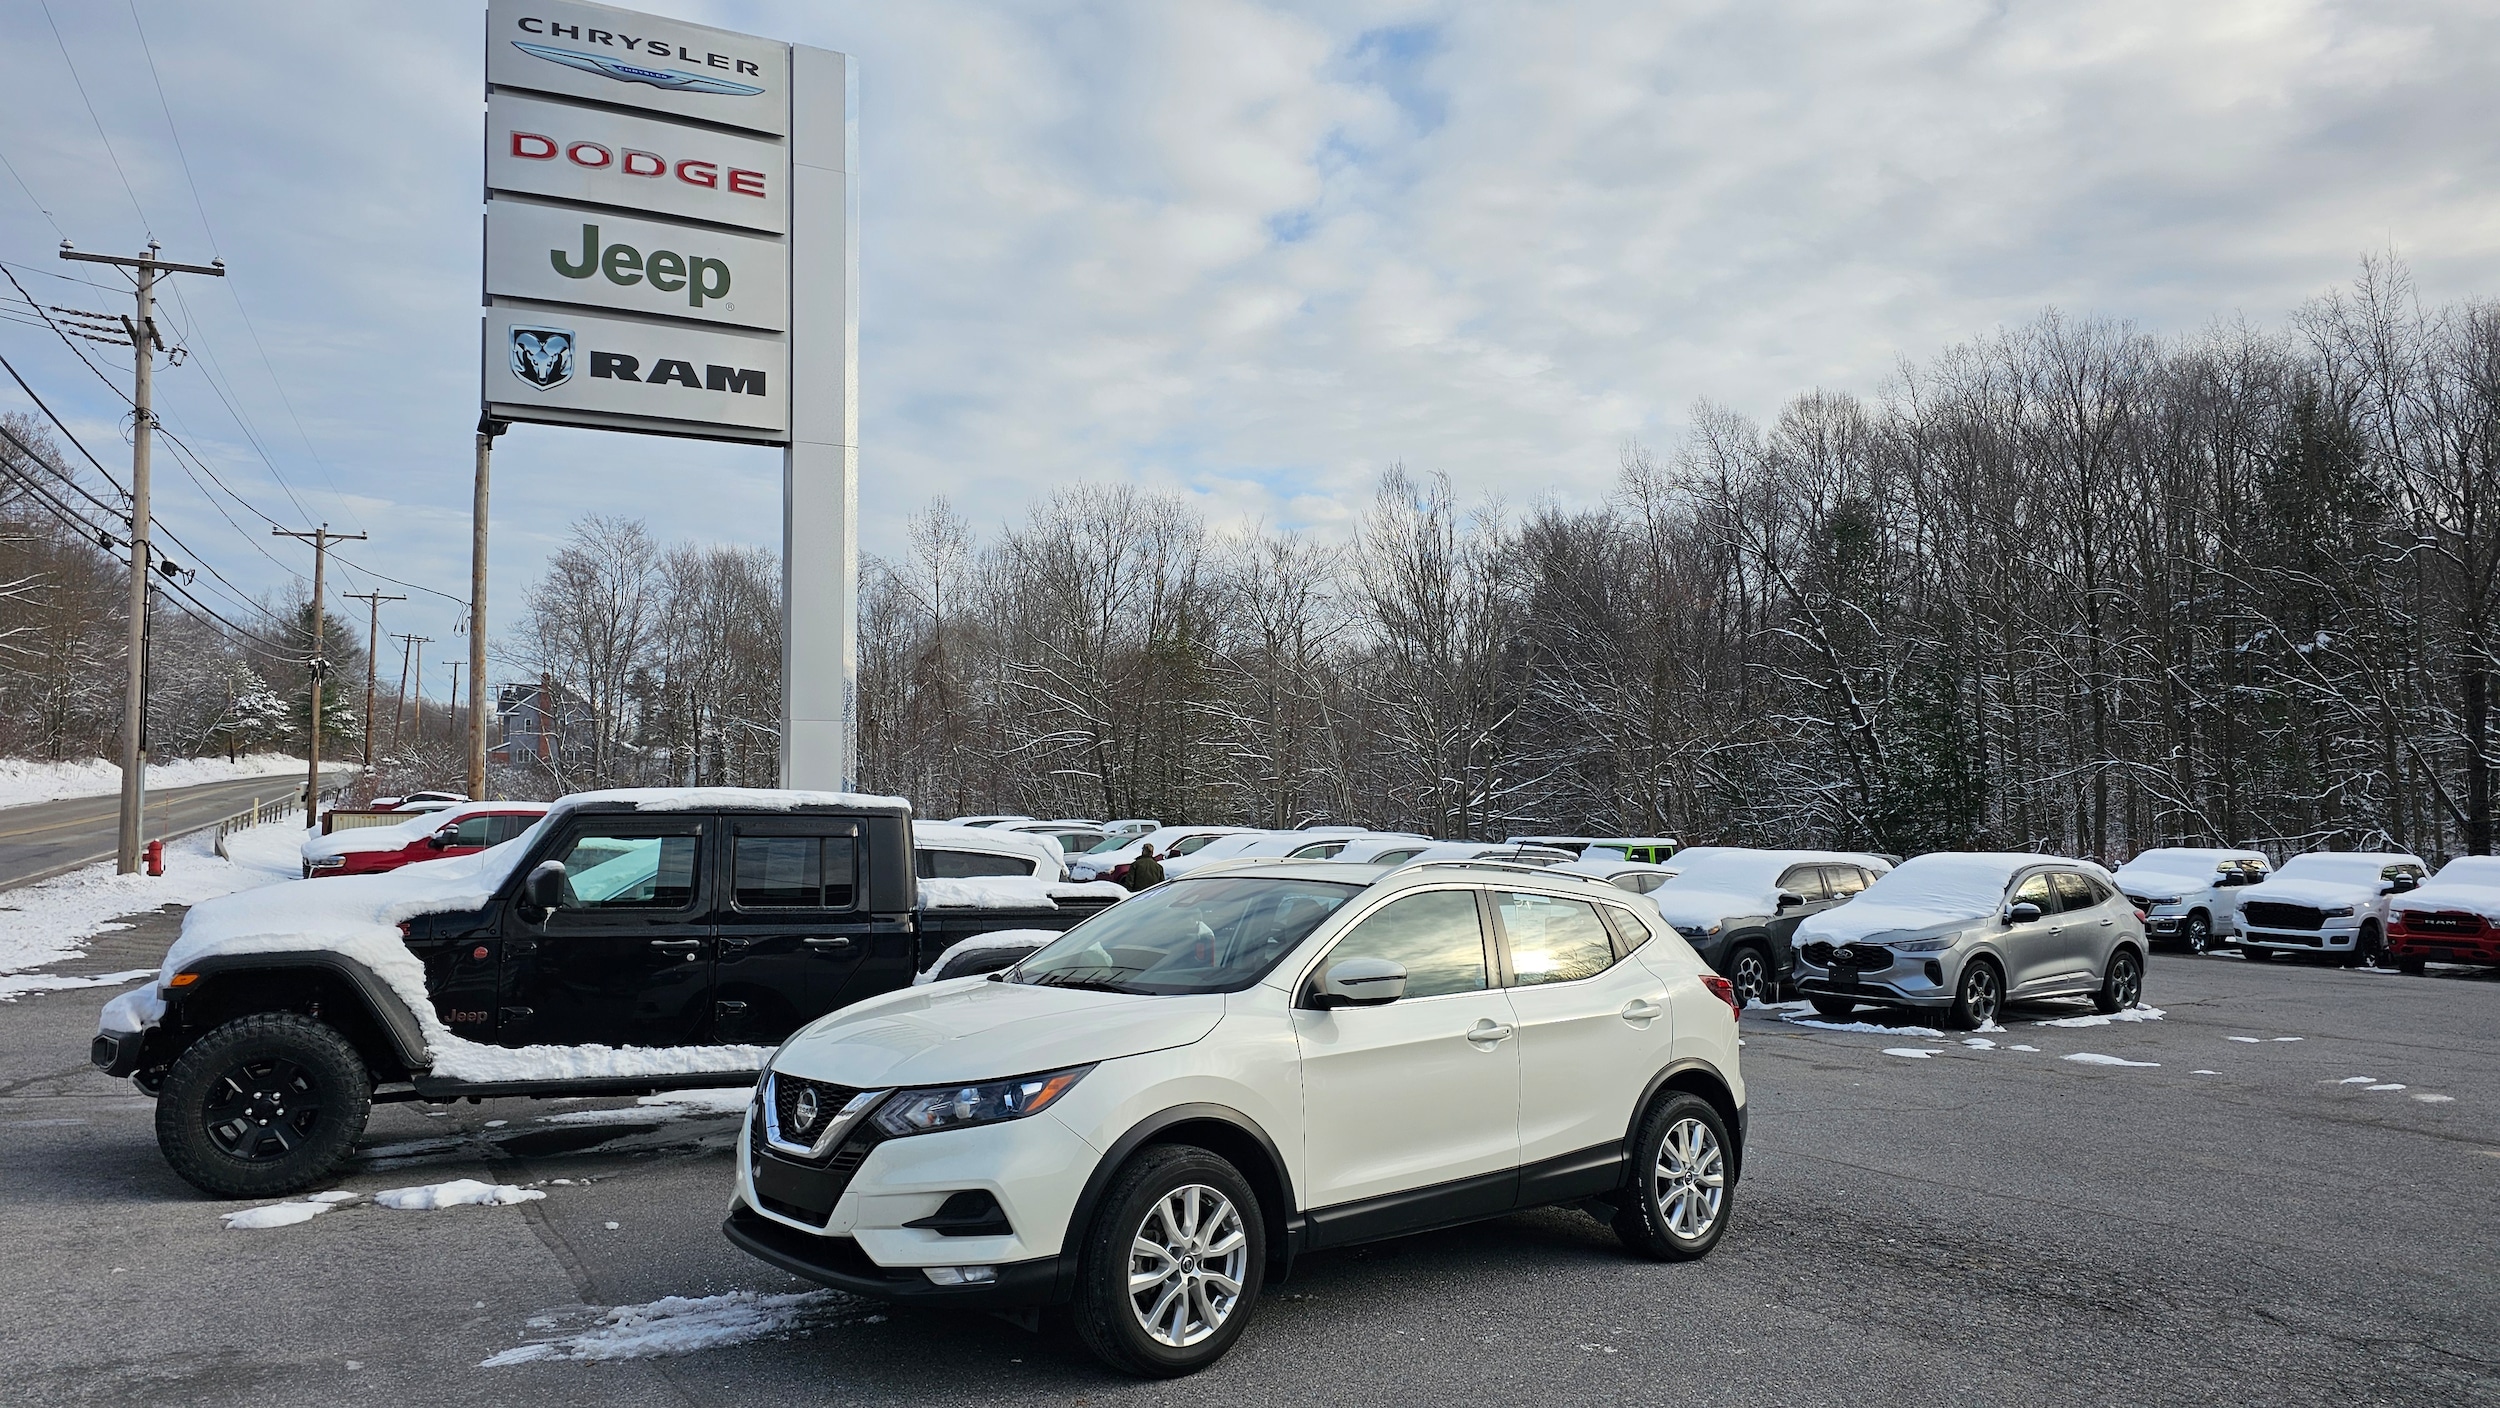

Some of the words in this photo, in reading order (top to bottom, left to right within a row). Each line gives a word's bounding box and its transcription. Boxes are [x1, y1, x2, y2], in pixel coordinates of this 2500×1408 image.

[517, 17, 760, 77] CHRYSLER
[618, 66, 668, 79] CHRYSLER
[510, 130, 767, 199] DODGE
[550, 224, 731, 308] Jeep
[590, 350, 766, 397] RAM
[444, 1008, 488, 1024] Jeep
